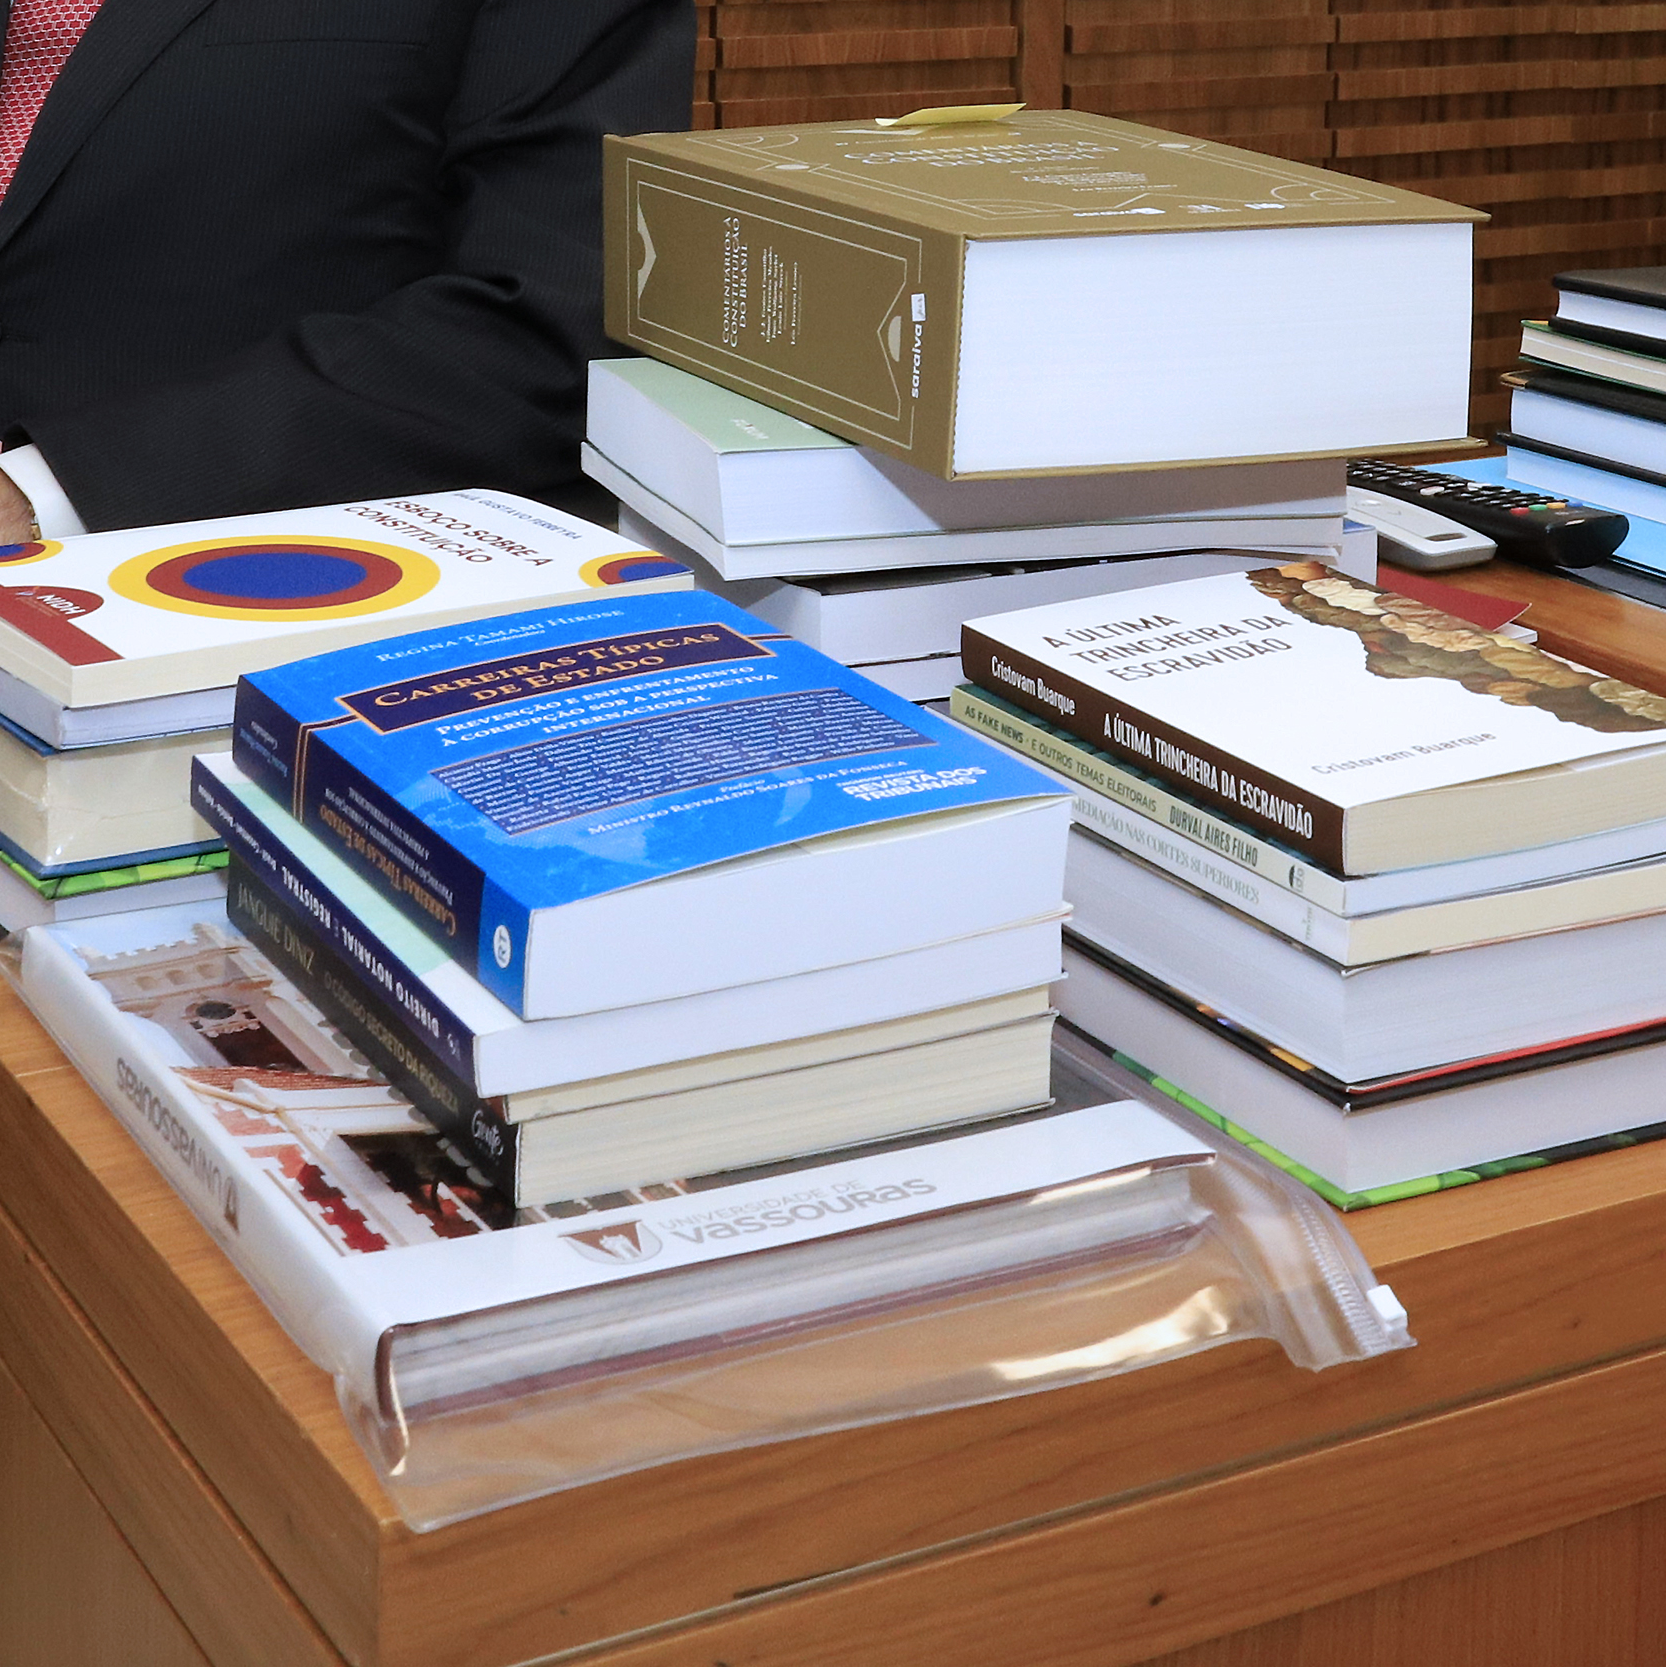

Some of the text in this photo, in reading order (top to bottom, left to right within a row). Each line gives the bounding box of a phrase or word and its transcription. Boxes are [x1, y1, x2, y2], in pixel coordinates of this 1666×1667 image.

[730, 217, 741, 348] CONSTITUIÇÃO
[739, 244, 749, 328] DO BRASIL
[911, 323, 923, 399] saraiva
[343, 506, 493, 563] CONSTITUIÇÃO
[385, 500, 554, 566] ESBOÇO SOBRE A
[479, 499, 533, 522] GUSTAVO
[532, 517, 583, 541] FERREYRA
[36, 594, 86, 615] NIDH
[1042, 614, 1182, 649] A ÚLTIMA
[375, 609, 625, 663] REGINA TAMAMI HIROSE
[1069, 614, 1294, 665] TRINCHEIRA DA
[1106, 637, 1293, 682] ESCRAVIDÃO
[374, 632, 721, 708] CARREIRAS TÍPICAS
[472, 655, 665, 703] DE ESTADO
[991, 655, 1076, 717] Cristovam Buarque
[436, 666, 755, 735] PREVENÇÃO E ENFRENTAMENTO
[441, 672, 779, 747] À CORRUPÇÃO SOB A PERSPECTIVA
[542, 695, 711, 734] INTERNACIONAL
[842, 766, 988, 796] REVISTA DOS
[1103, 713, 1314, 840] A ÚLTIMA TRINCHEIRA DA ESCRAVIDÃO
[1310, 731, 1497, 775] Cristovam Buarque
[588, 760, 908, 835] MINISTRO REYNALDO SOARES DA FONSECA
[720, 778, 765, 793] Prefácio
[855, 776, 979, 802] TRIBUNAIS
[964, 705, 1258, 868] AS FAKE NEWS E OUTROS TEMAS ELEITORAIS DURVAL AIRES FILHO
[319, 804, 353, 848] ESTADO
[366, 847, 402, 891] TÍPICAS
[1124, 823, 1146, 844] NAS
[1147, 832, 1189, 868] CORTES
[1190, 850, 1260, 905] SUPERIORES
[282, 866, 332, 929] REGISTRAL
[404, 881, 457, 937] CARREIRAS
[342, 926, 393, 991] NOTARIAL
[283, 937, 314, 976] DINIZ
[366, 1007, 404, 1063] SECRETO
[405, 1047, 421, 1075] DA
[396, 981, 439, 1038] DIREITO
[658, 1179, 864, 1229] UNIVERSIDADE DE
